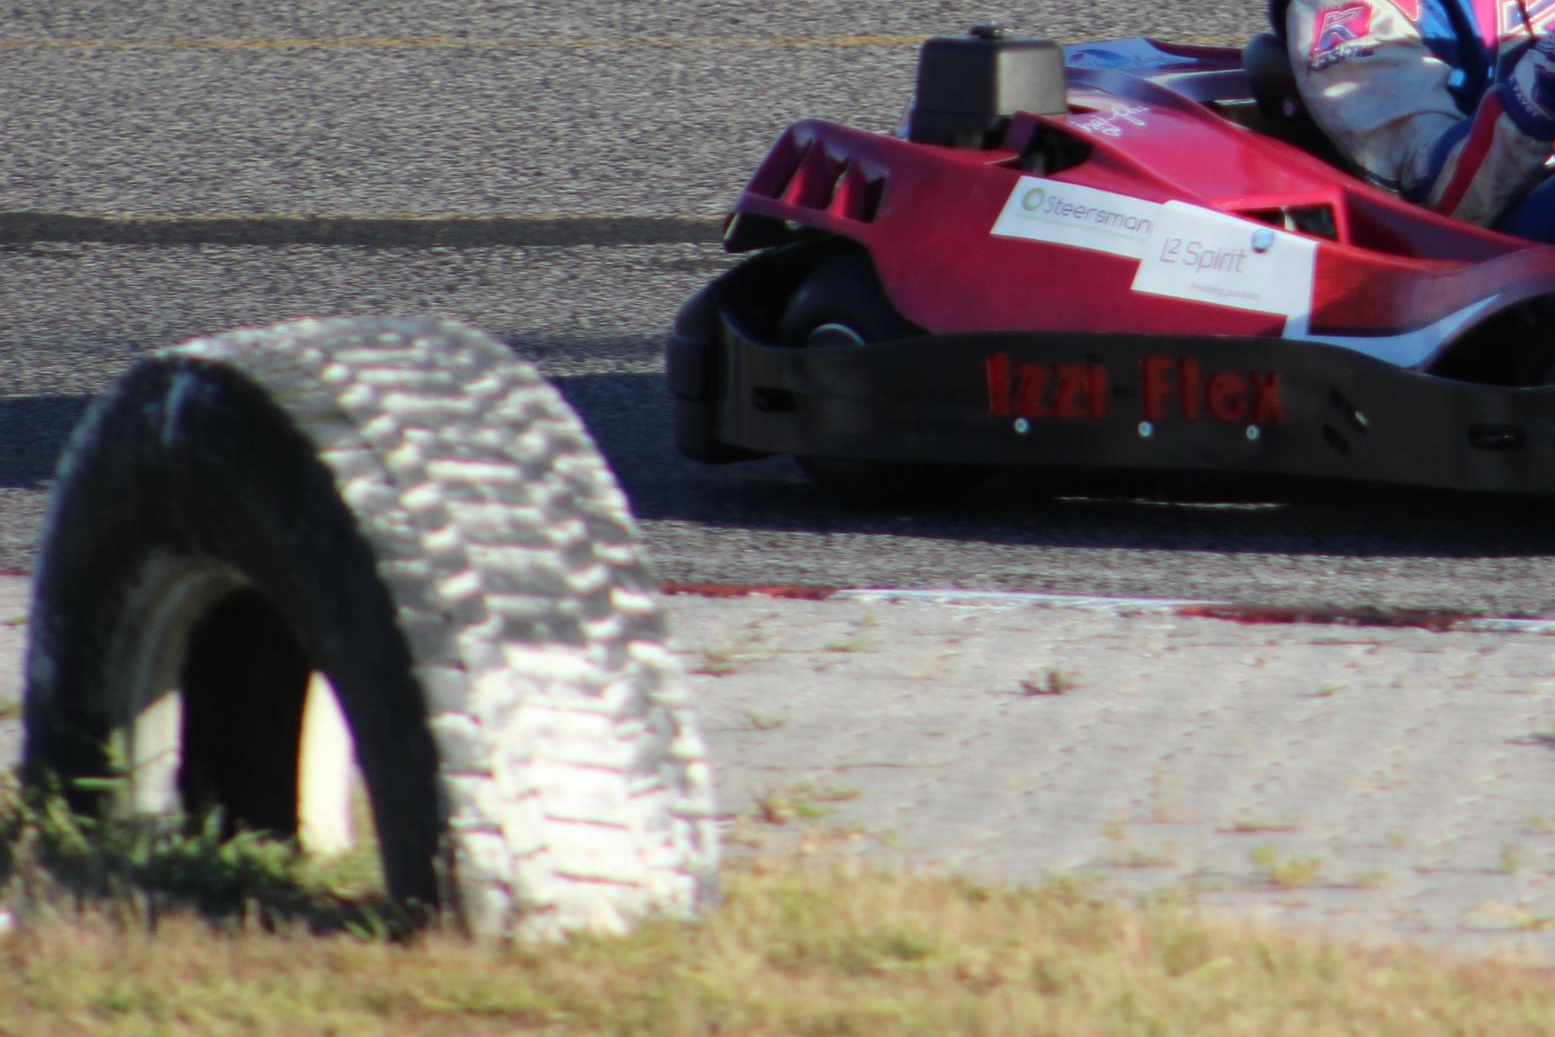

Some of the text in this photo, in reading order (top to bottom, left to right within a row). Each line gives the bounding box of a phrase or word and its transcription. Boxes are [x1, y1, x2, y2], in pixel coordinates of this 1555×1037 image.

[1042, 195, 1151, 233] Steersman
[1182, 241, 1247, 274] Spirit
[1140, 355, 1285, 422] Flex
